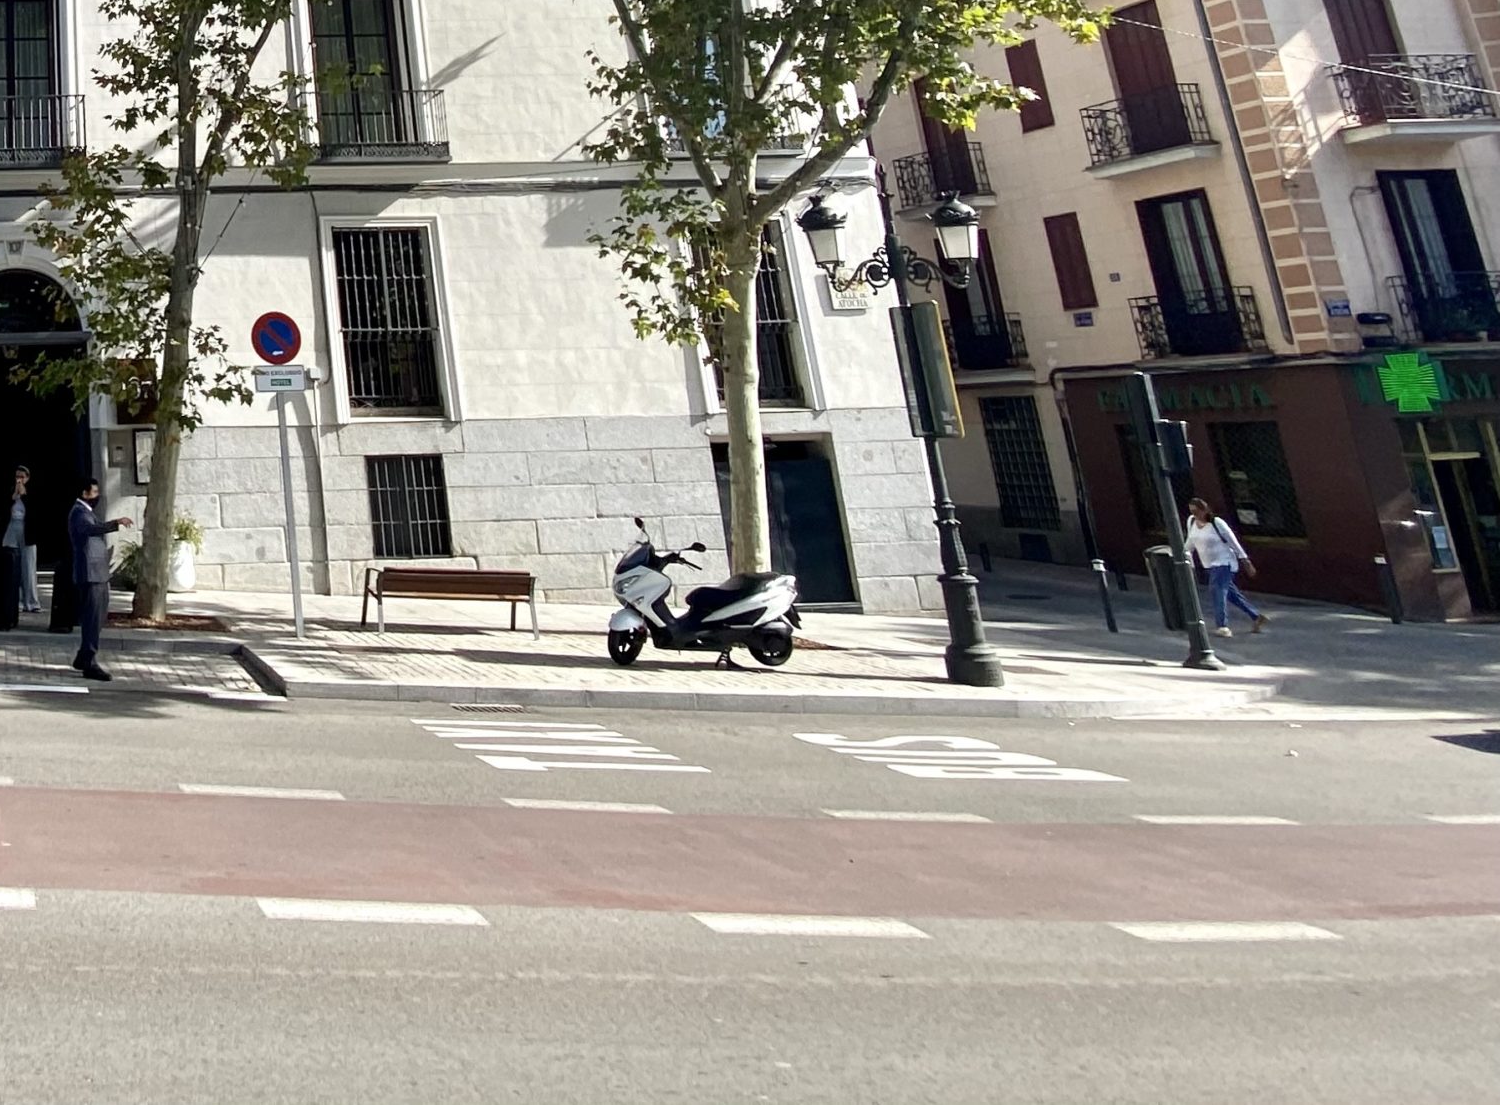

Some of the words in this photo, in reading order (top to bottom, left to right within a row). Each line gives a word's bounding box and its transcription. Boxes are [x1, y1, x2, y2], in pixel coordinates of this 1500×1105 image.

[838, 299, 868, 307] ATOCHA
[1098, 382, 1273, 410] FAMACIA
[410, 718, 712, 772] TAXI
[792, 732, 1131, 781] BUS
